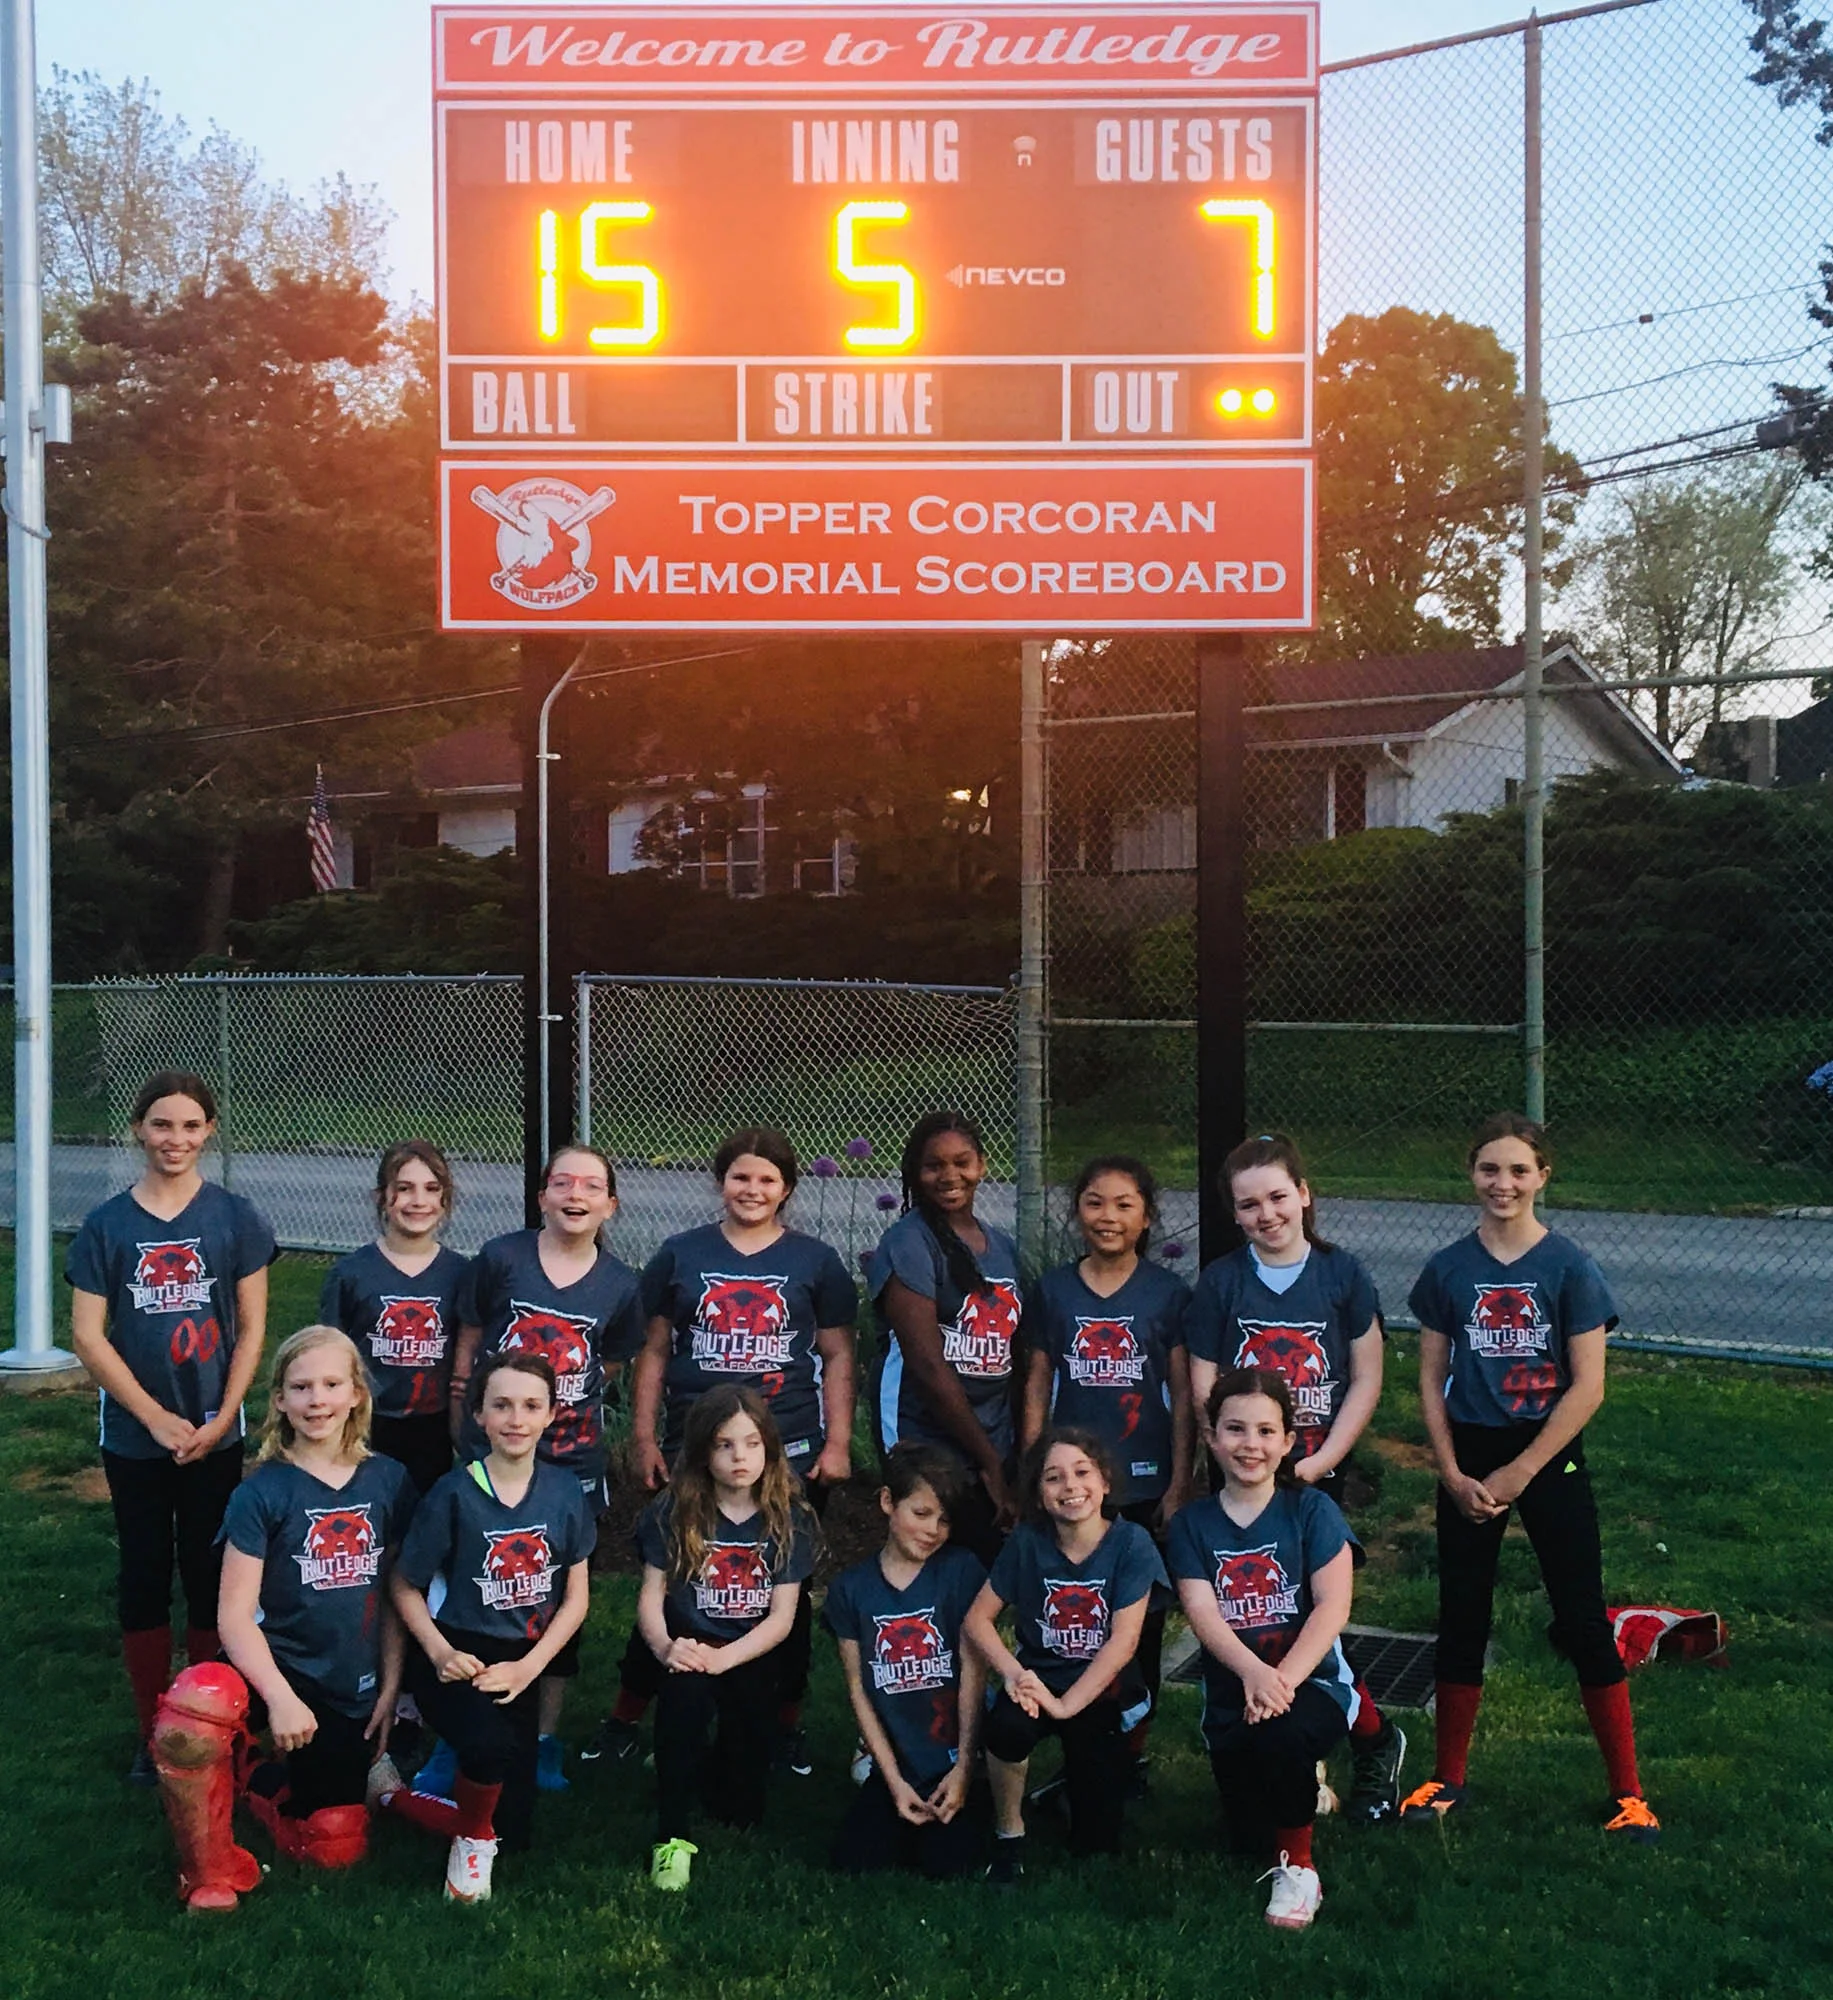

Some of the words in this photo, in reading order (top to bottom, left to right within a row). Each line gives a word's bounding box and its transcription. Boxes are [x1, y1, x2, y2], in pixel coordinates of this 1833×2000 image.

[470, 26, 807, 66] Welcome
[823, 32, 902, 66] to
[916, 19, 1282, 76] Rutledge
[505, 120, 634, 184] HOME
[792, 120, 960, 184] INNING
[1095, 118, 1273, 183] GUESTS
[537, 200, 663, 348] 15
[834, 200, 919, 348] 5
[1200, 198, 1276, 338] 7
[472, 371, 576, 435] BALL
[774, 372, 933, 436] STRIKE
[1093, 370, 1179, 434] OUT
[679, 495, 892, 535] TOPPER
[908, 495, 1217, 535] CORCORAN
[613, 555, 901, 595] MEMORIAL
[915, 555, 1287, 595] SCOREBOARD
[509, 583, 580, 604] WOLFPACK
[136, 1283, 209, 1305] RUTLEDGE
[373, 1339, 444, 1356] RUTLEDGE
[694, 1333, 789, 1358] RUTLEDGE
[947, 1331, 1010, 1357] RUTLE
[1473, 1328, 1545, 1347] RUTLEDGE
[702, 1360, 772, 1371] WOLFPACK
[1072, 1359, 1143, 1376] RUTLEDGE
[304, 1554, 377, 1580] RUTLEDGE
[485, 1572, 552, 1600] RUTLEDGE
[1043, 1629, 1104, 1646] RUTLEDG
[874, 1658, 952, 1686] RUTLEDGE
